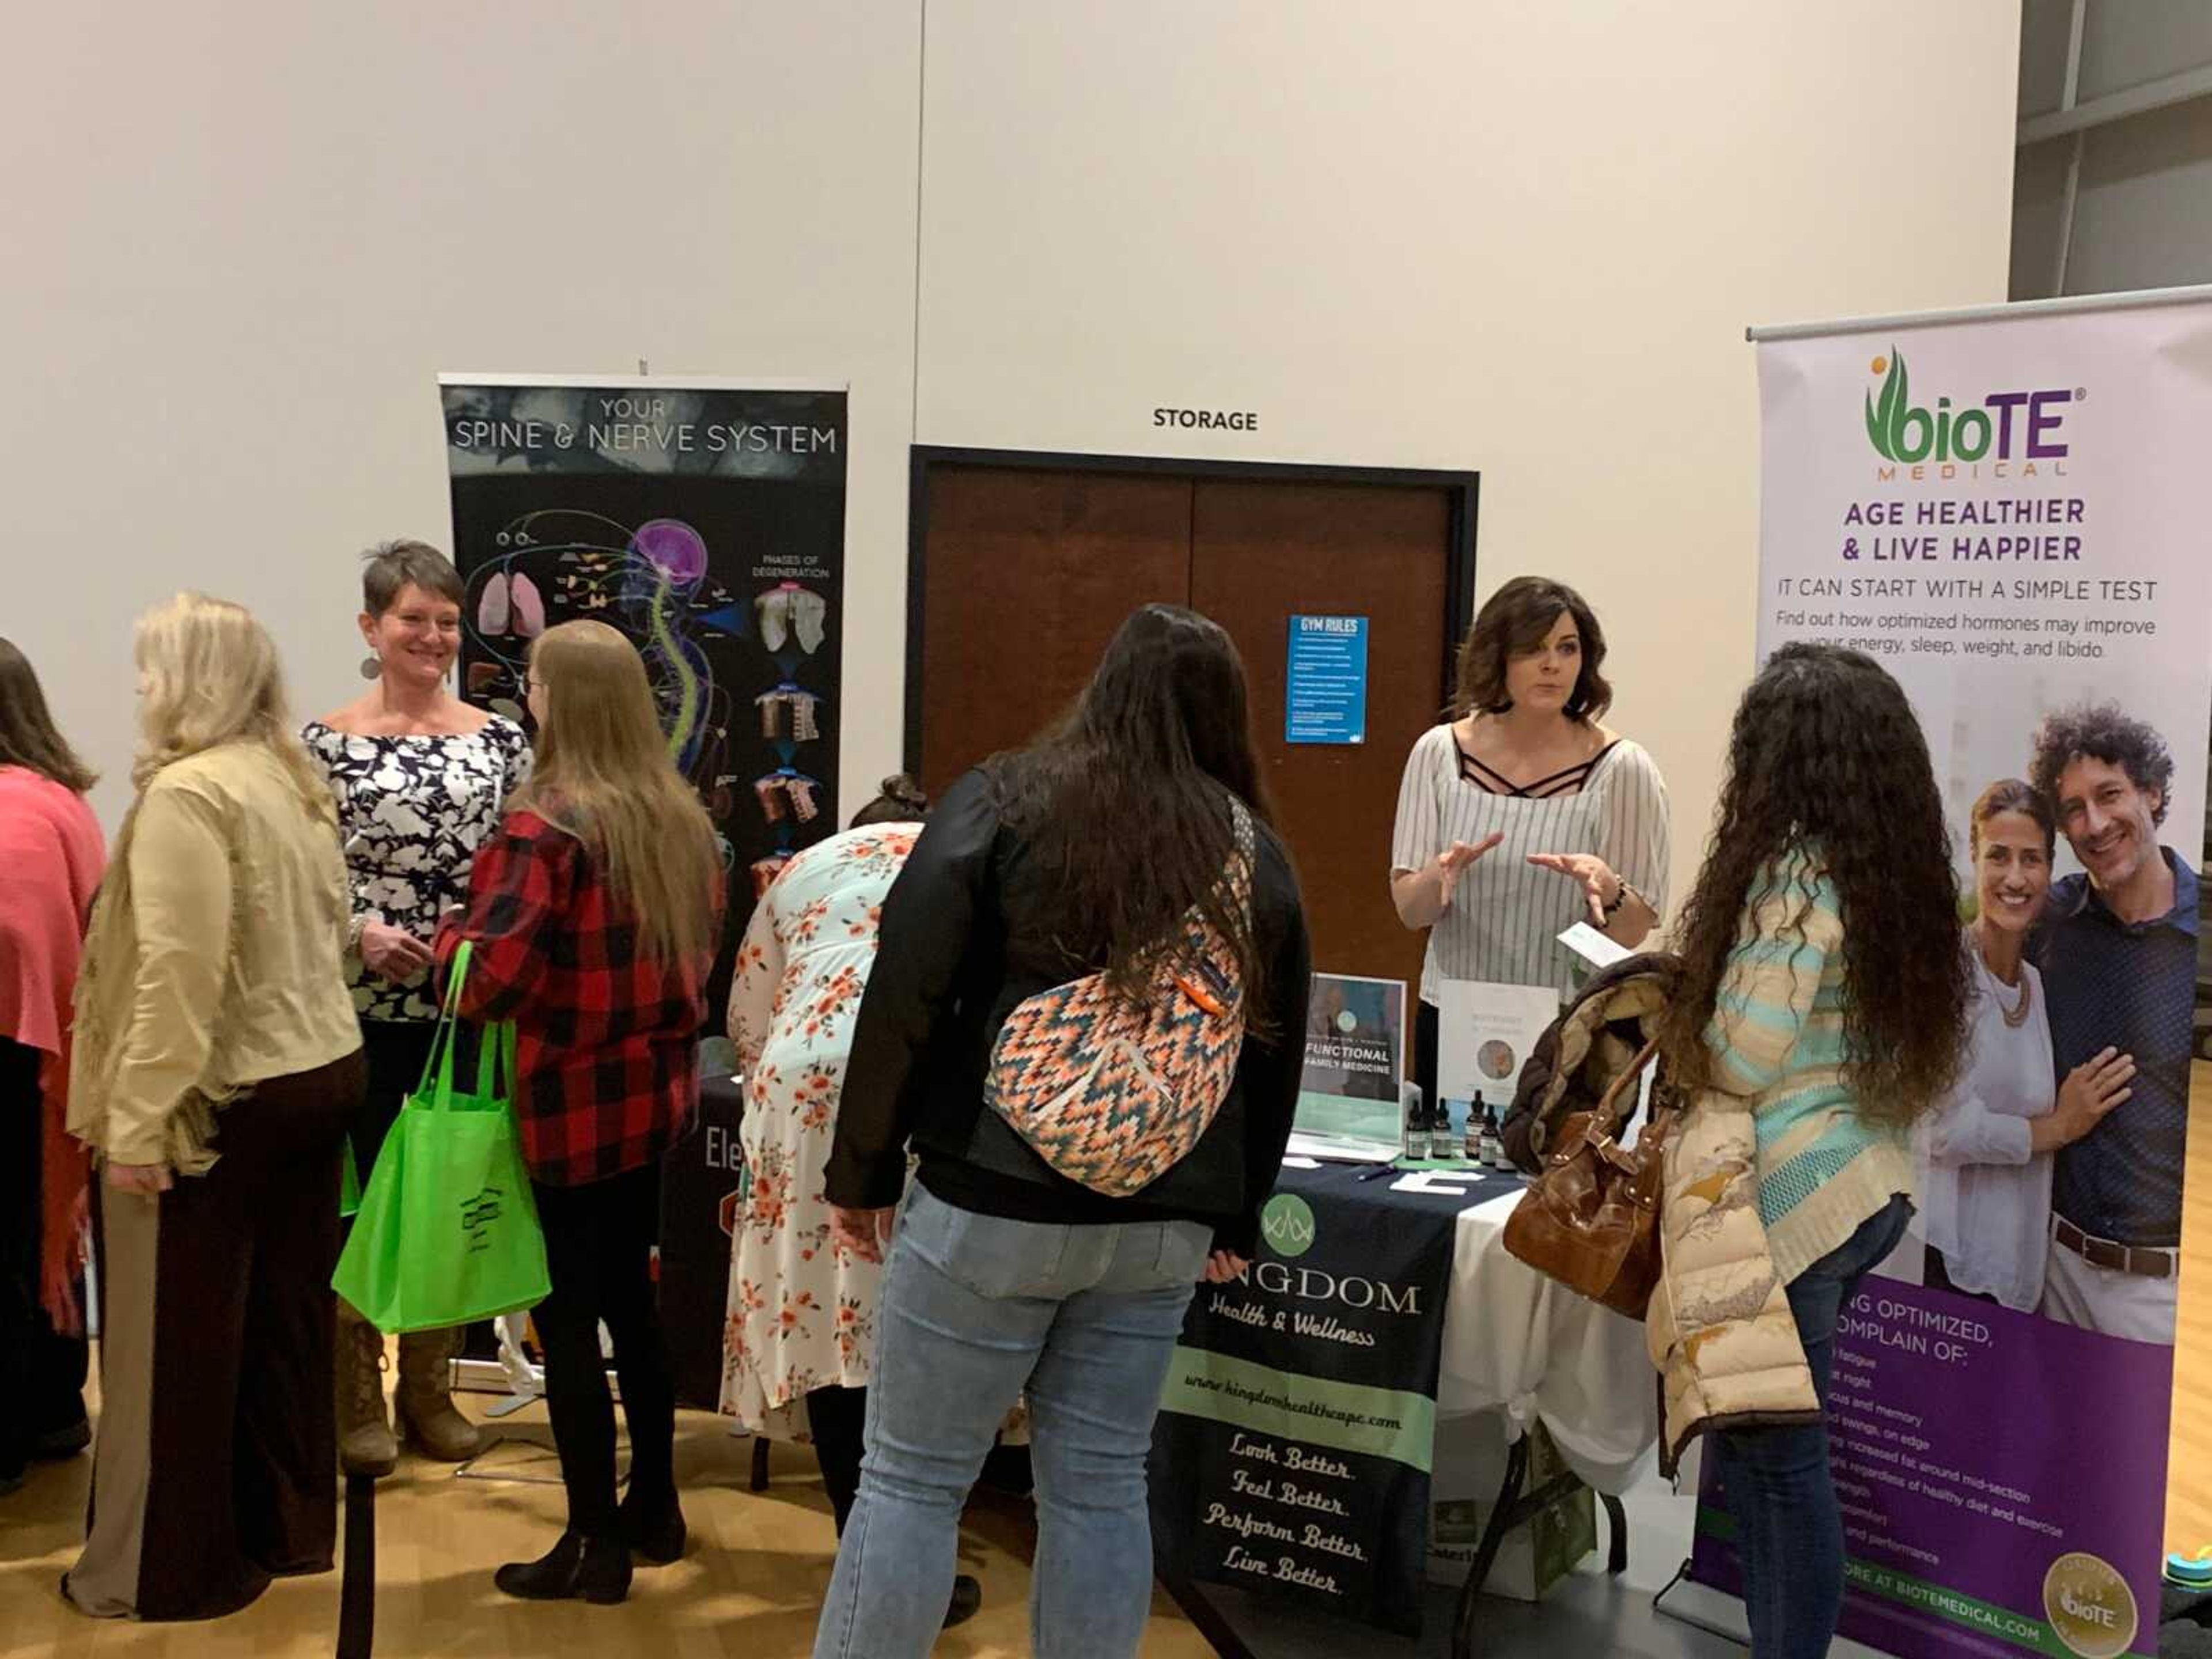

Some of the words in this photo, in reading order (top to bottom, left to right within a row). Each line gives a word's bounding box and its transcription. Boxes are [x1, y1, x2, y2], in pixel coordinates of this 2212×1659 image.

[601, 399, 665, 418] YOUR
[1154, 408, 1257, 431] STORAGE
[455, 421, 543, 449] SPINE
[554, 422, 575, 449] &
[589, 423, 695, 451] NERVE
[707, 425, 835, 453] SYSTEM
[1878, 462, 2069, 482] MEDICAL
[1844, 502, 1904, 525] AGE
[1916, 499, 2085, 525] HEALTHIER
[1843, 537, 1860, 560] &
[1874, 537, 1938, 560] LIVE
[1952, 536, 2081, 560] HAPPIER
[1778, 578, 1793, 595] IT
[1799, 578, 1843, 596] CAN
[1850, 579, 1917, 597] START
[1926, 580, 1983, 599] WITH
[1991, 581, 2006, 599] A
[2014, 580, 2090, 600] SIMPLE
[2099, 581, 2158, 601] TEST
[1301, 618, 1323, 632] GYM
[1326, 619, 1357, 633] RULES
[1775, 610, 1805, 626] Find
[1809, 613, 1834, 627] out
[1839, 612, 1873, 627] how
[1877, 613, 1957, 630] optimized
[1962, 614, 2039, 631] hormones
[2045, 619, 2078, 634] may
[2085, 616, 2156, 635] improve
[1848, 638, 1906, 654] energy,
[1911, 638, 1957, 656] sleep,
[2024, 641, 2052, 656] and
[1304, 1057, 1340, 1069] FAMILY
[1343, 1062, 1390, 1075] MEDICINE
[1305, 1042, 1389, 1062] FUNCTIONAL
[1238, 1260, 1422, 1314] NGDOM
[1210, 1293, 1267, 1327] Health
[1272, 1311, 1286, 1331] &
[1296, 1311, 1374, 1347] Wellness
[1877, 1300, 1993, 1348] OPTIMIZED,
[1836, 1316, 1926, 1354] OMPLAIN
[1934, 1341, 1968, 1368] OF:
[1852, 1397, 1873, 1411] and
[1875, 1405, 1924, 1428] memory
[1229, 1433, 1278, 1464] Look
[1884, 1430, 1899, 1441] on
[1901, 1435, 1930, 1450] edge
[1230, 1469, 1274, 1500] Feel
[1847, 1441, 1899, 1464] increased
[1902, 1454, 1916, 1468] fat
[1919, 1463, 1960, 1482] around
[1963, 1475, 2031, 1505] mid-section
[1850, 1462, 1906, 1488] regardless
[1908, 1480, 1920, 1491] of
[1923, 1483, 1965, 1507] healthy
[1967, 1498, 1988, 1515] diet
[1991, 1506, 2014, 1522] and
[2017, 1514, 2064, 1539] exercise
[1203, 1502, 1296, 1543] Perform
[1222, 1546, 1268, 1575] Live
[1874, 1573, 1891, 1588] AT
[1896, 1581, 2041, 1642] BIOTEMEDICAL.COM
